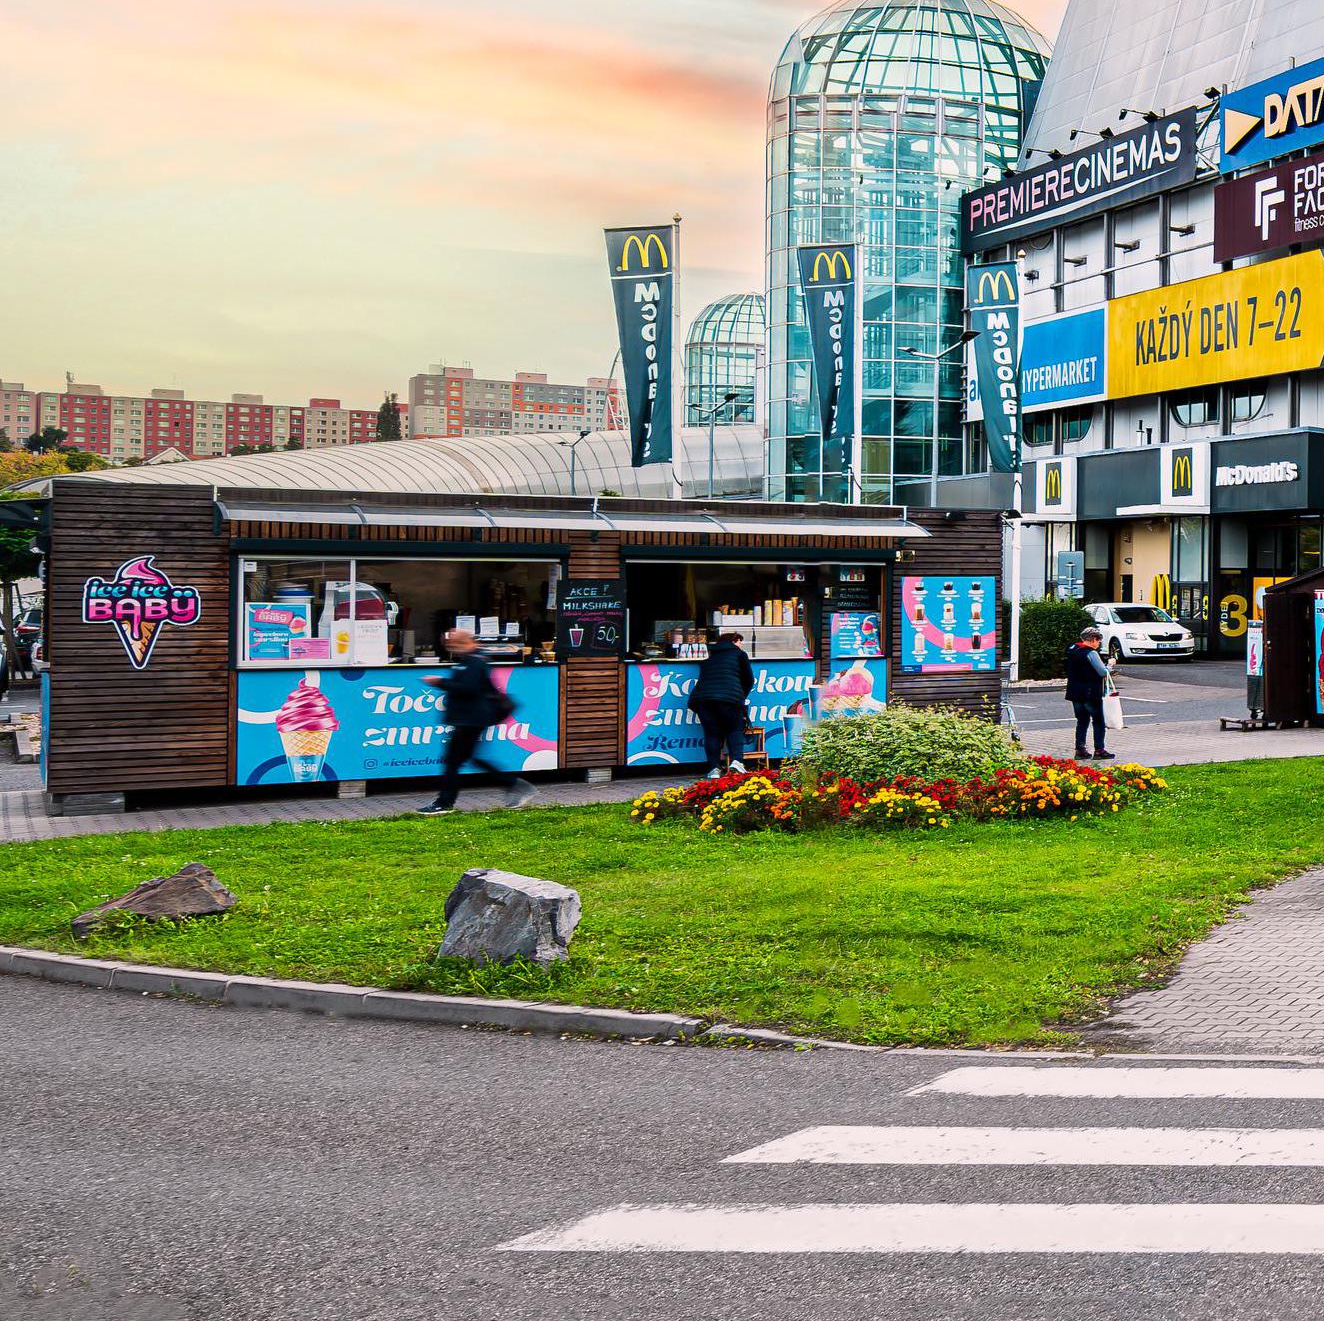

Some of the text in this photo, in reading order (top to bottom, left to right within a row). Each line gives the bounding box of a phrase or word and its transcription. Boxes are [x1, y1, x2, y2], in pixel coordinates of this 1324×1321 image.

[1294, 215, 1319, 233] fitness
[1135, 300, 1193, 366] KAŽDÝ
[1200, 300, 1239, 355] DEN
[1215, 461, 1299, 487] McDonald's
[569, 587, 599, 596] AKCE
